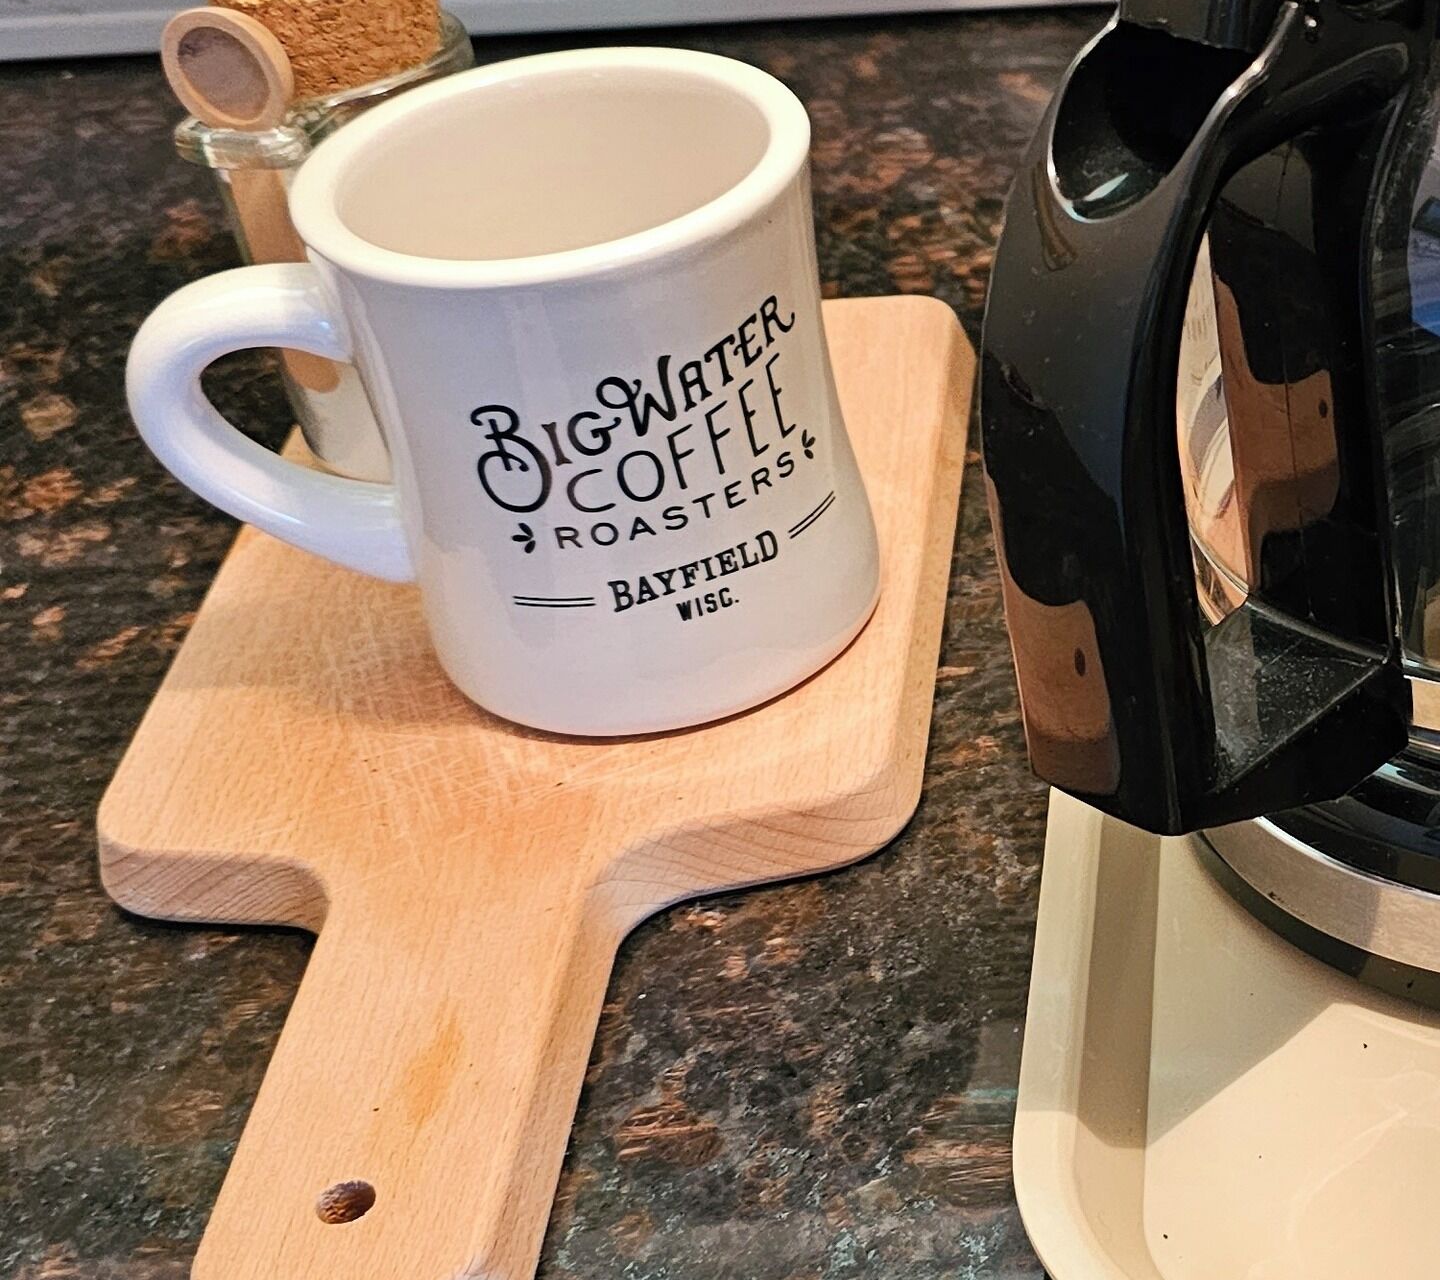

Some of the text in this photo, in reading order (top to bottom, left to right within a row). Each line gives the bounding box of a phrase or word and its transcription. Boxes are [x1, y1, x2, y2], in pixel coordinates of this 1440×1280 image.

[566, 352, 797, 513] COFFEE
[553, 450, 796, 550] ROASTERS
[607, 528, 779, 613] BAYFIELD
[676, 586, 740, 622] WISC.
